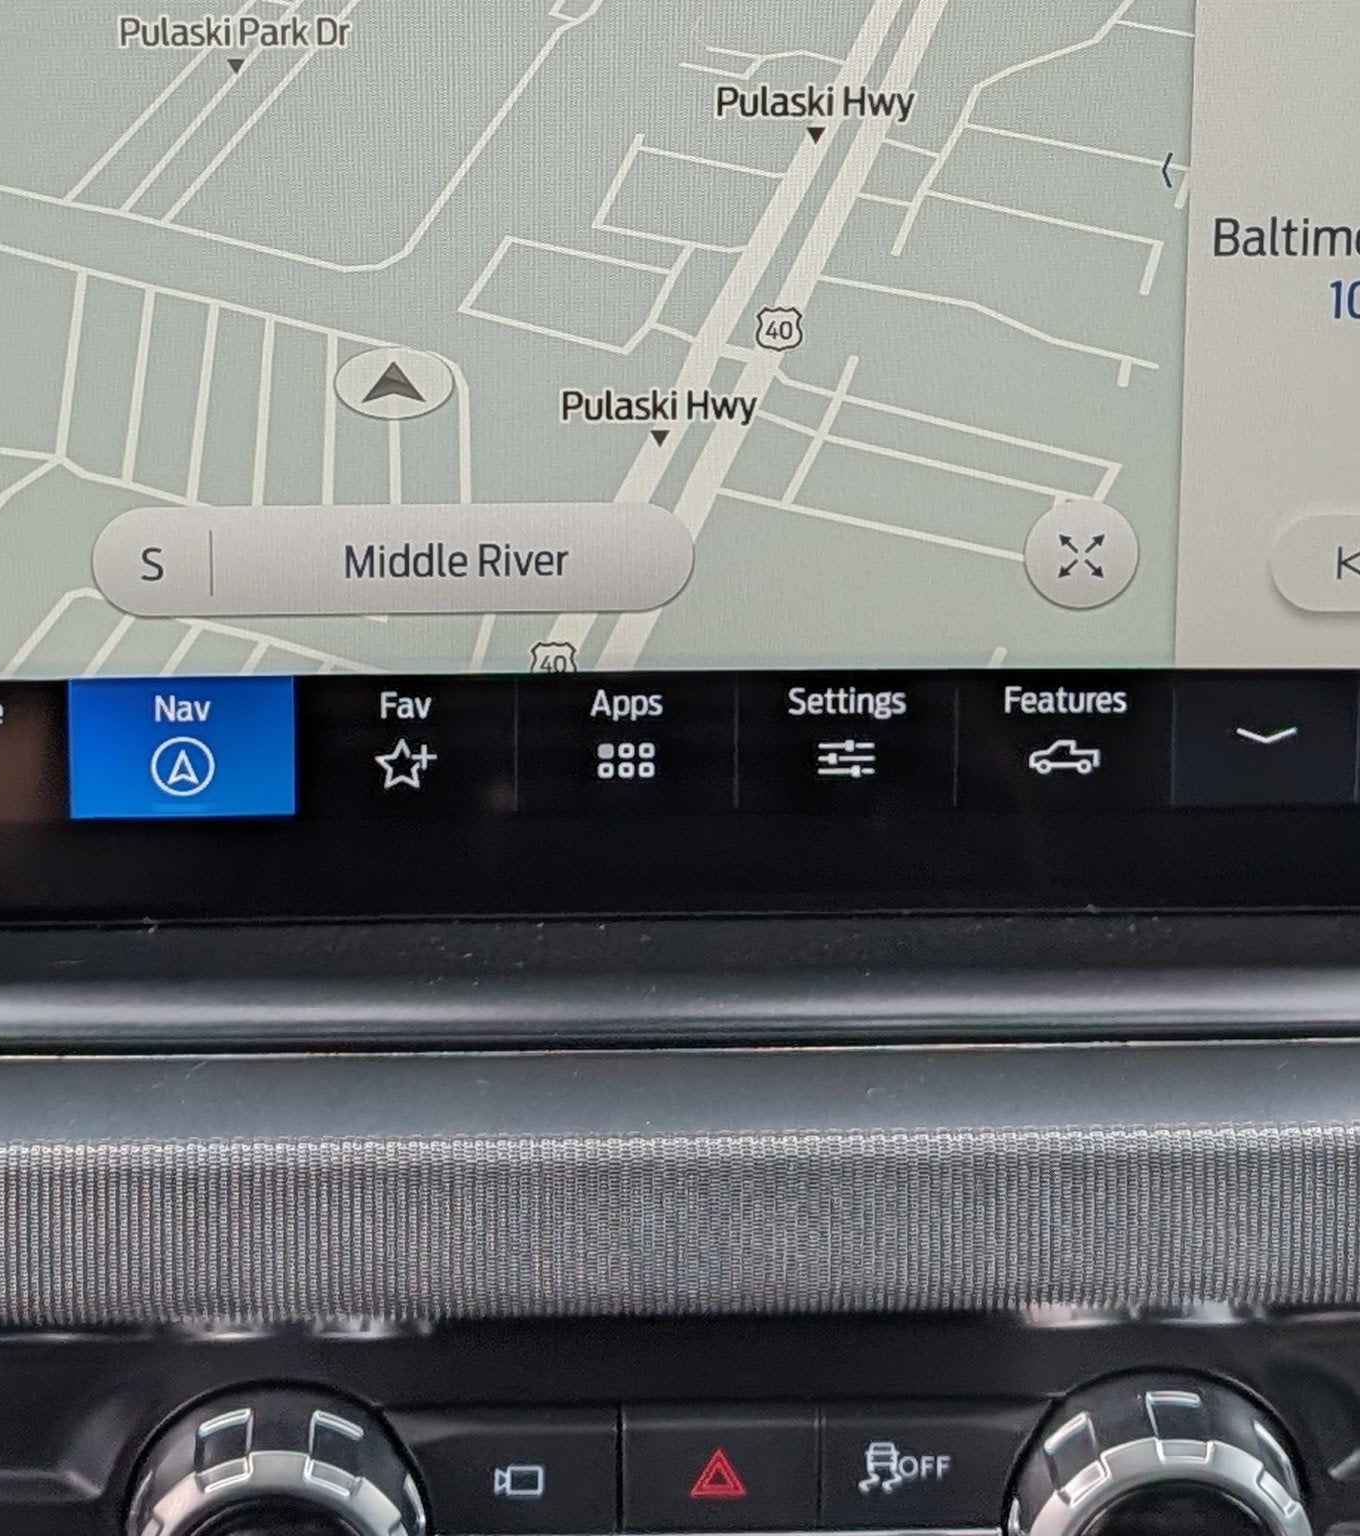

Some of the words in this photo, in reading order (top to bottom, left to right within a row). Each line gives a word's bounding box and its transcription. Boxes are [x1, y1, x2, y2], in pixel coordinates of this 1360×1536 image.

[121, 17, 230, 47] Pulaski
[239, 16, 308, 46] Park
[317, 17, 350, 46] Dr
[717, 85, 834, 117] Pulaski
[843, 86, 915, 122] Hwy
[765, 320, 793, 341] 40
[562, 390, 677, 421] Pulaski
[687, 390, 757, 426] Hwy
[141, 547, 164, 582] S
[345, 542, 468, 579] Middle
[478, 543, 569, 577] River
[155, 695, 211, 722] Nav
[380, 691, 432, 719] Fav
[590, 689, 663, 721] Apps
[788, 687, 906, 719] Settings
[1004, 686, 1127, 713] Features
[900, 1455, 951, 1479] OFF
